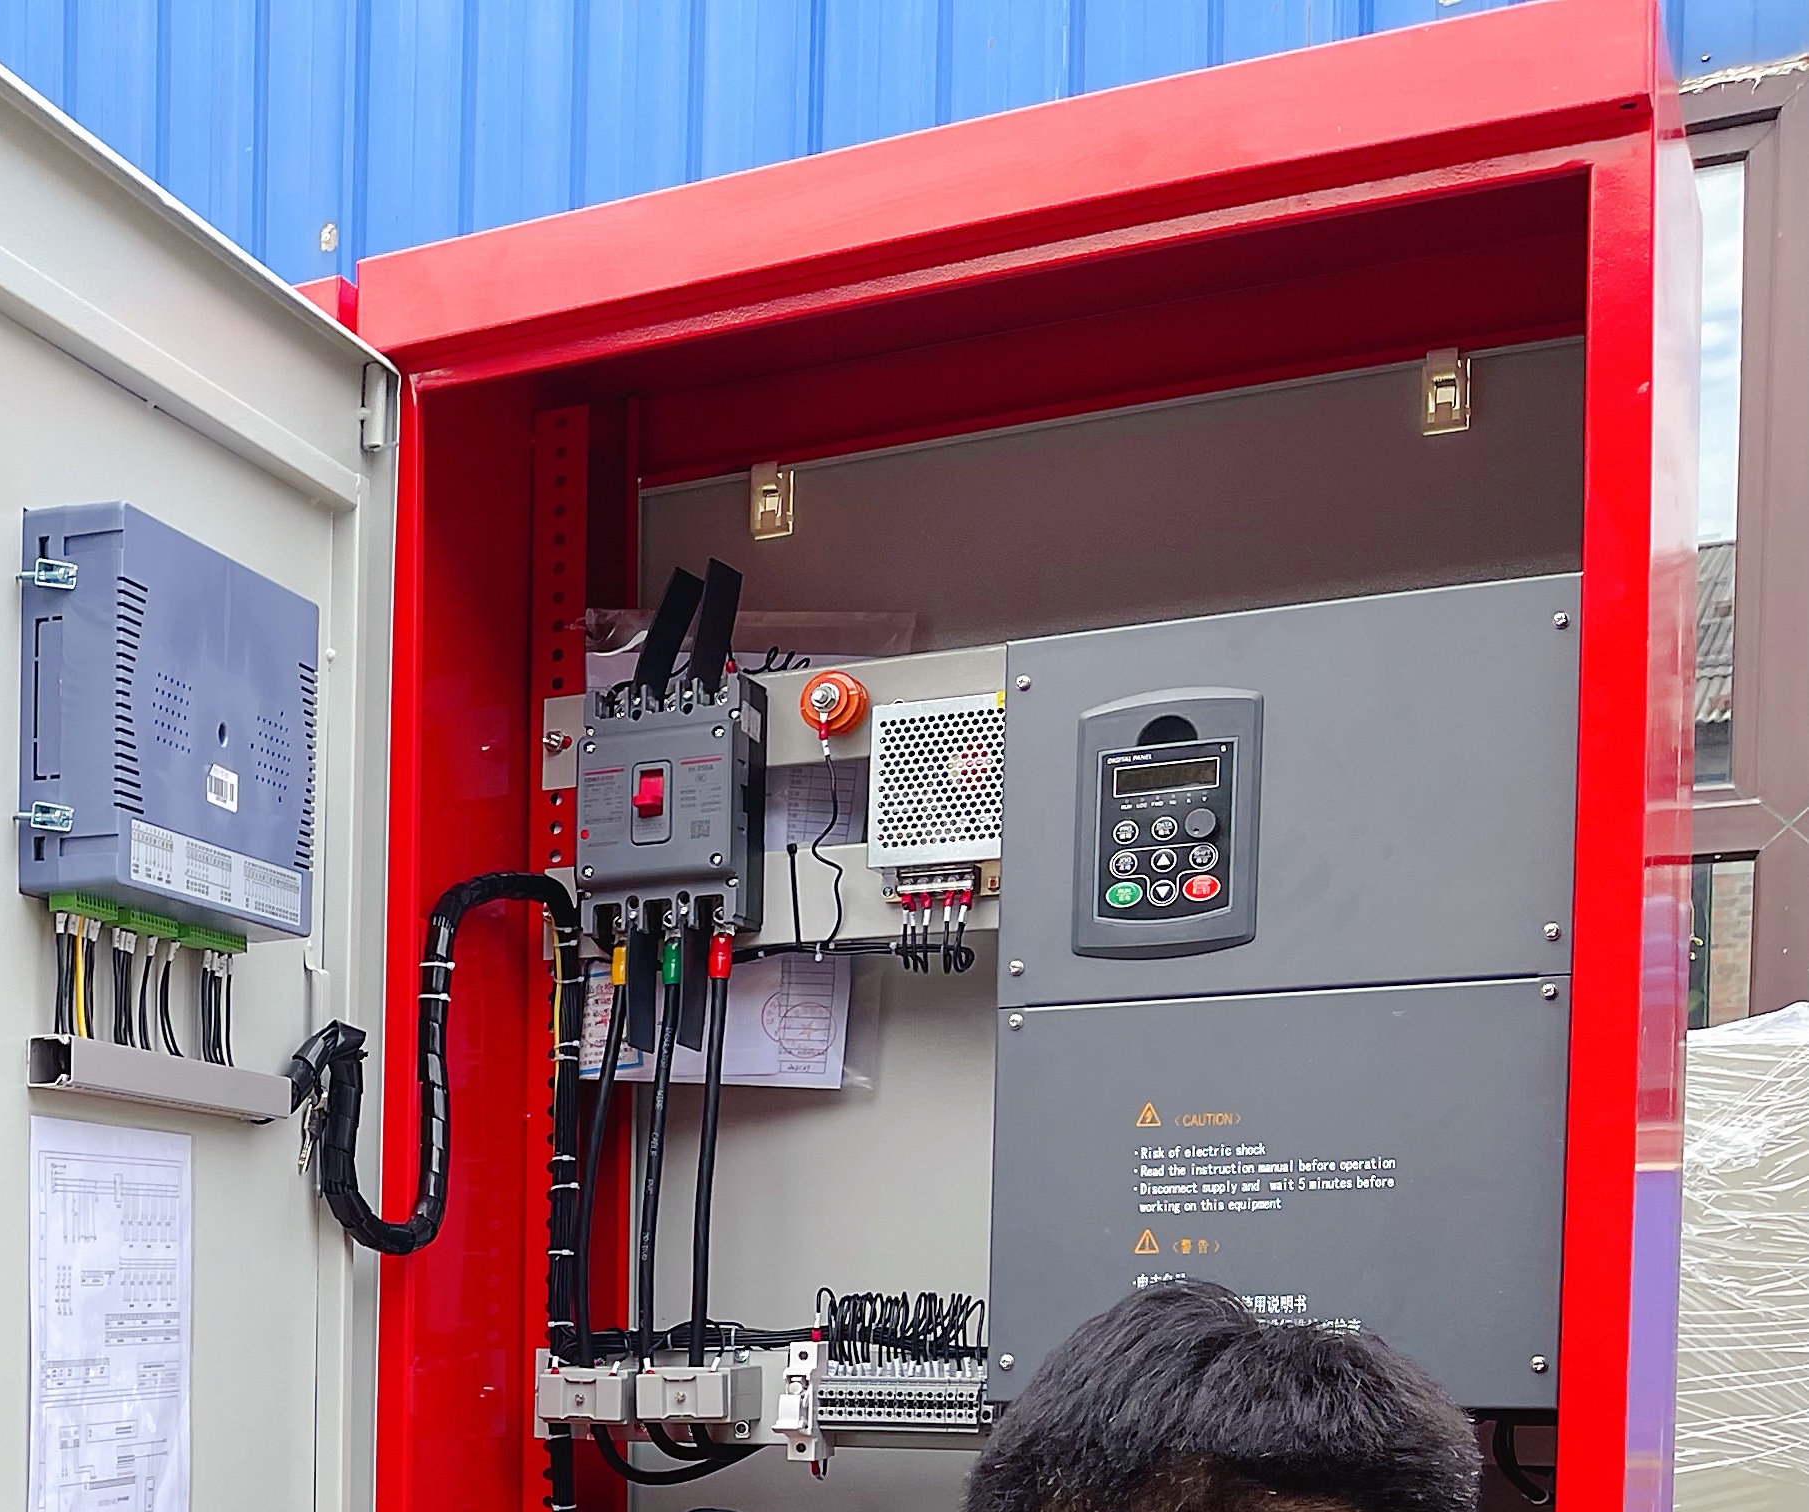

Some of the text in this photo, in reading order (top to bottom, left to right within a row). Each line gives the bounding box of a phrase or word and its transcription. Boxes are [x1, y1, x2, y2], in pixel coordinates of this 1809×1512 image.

[1140, 1143, 1266, 1159] Risk of electric shock
[1140, 1157, 1396, 1177] Read the instruction manual before operation
[1139, 1176, 1395, 1195] Disconnect supply and wait 5 minutes before
[1139, 1198, 1282, 1215] working on this equipment
